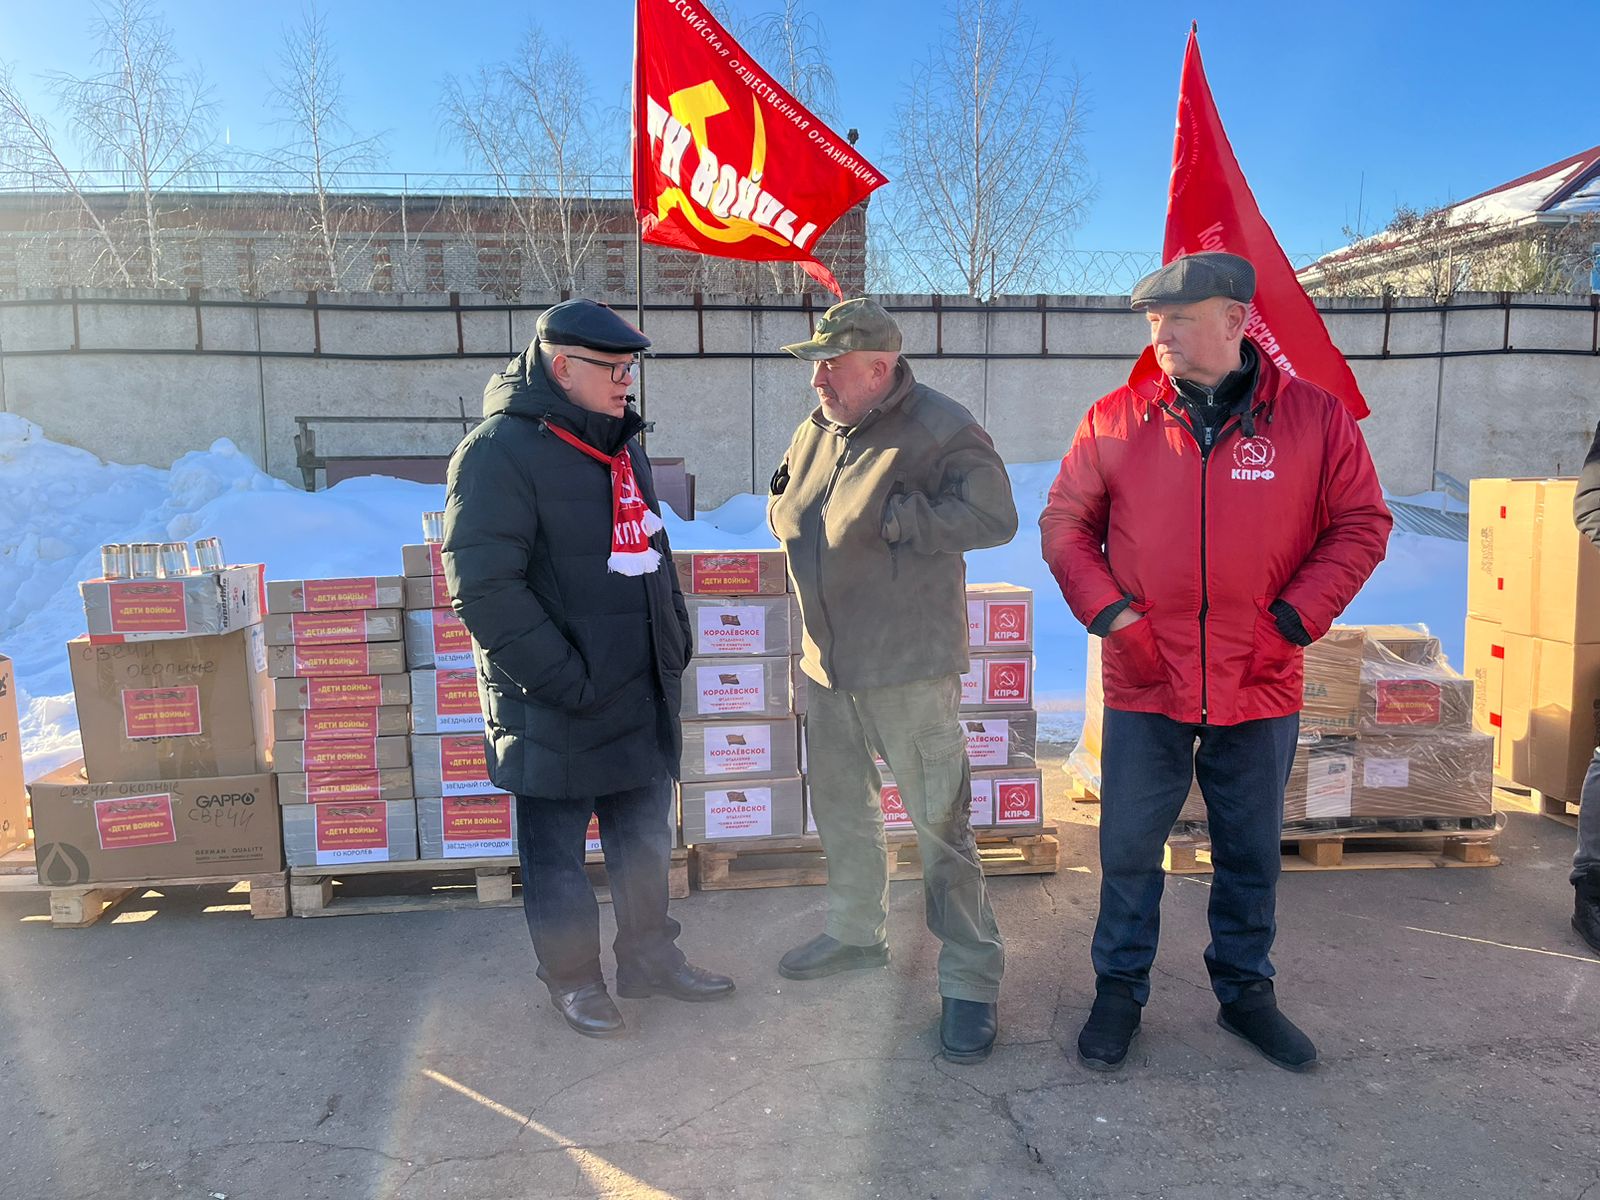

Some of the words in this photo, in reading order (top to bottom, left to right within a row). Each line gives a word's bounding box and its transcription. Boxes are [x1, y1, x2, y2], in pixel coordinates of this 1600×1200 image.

[667, 0, 730, 57] ССИЙСКАЯ
[728, 59, 809, 130] ОБЩЕСТВЕННАЯ
[808, 129, 877, 186] ОРГАНИЗАЦИЯ
[646, 94, 692, 187] ТИ
[690, 144, 818, 249] ВОЙНЫ
[1231, 468, 1275, 480] КПРФ
[614, 519, 645, 545] КПР
[704, 628, 760, 636] КОРОЛЁВСКОЕ
[994, 631, 1020, 639] КПРФ
[703, 687, 759, 696] КОРОЛЁВСКОЕ
[994, 689, 1020, 697] КПРФ
[966, 735, 1004, 743] ОЛЁВСКОЕ
[710, 747, 766, 757] КОРОЛЁВСКОЕ
[472, 758, 487, 766] ВОЙ
[195, 792, 255, 808] GAPPO
[711, 805, 767, 814] КОРОЛЁВСКОЕ
[883, 812, 908, 820] КПРФ
[1004, 810, 1031, 818] КПРФ
[232, 846, 263, 854] QUALITY
